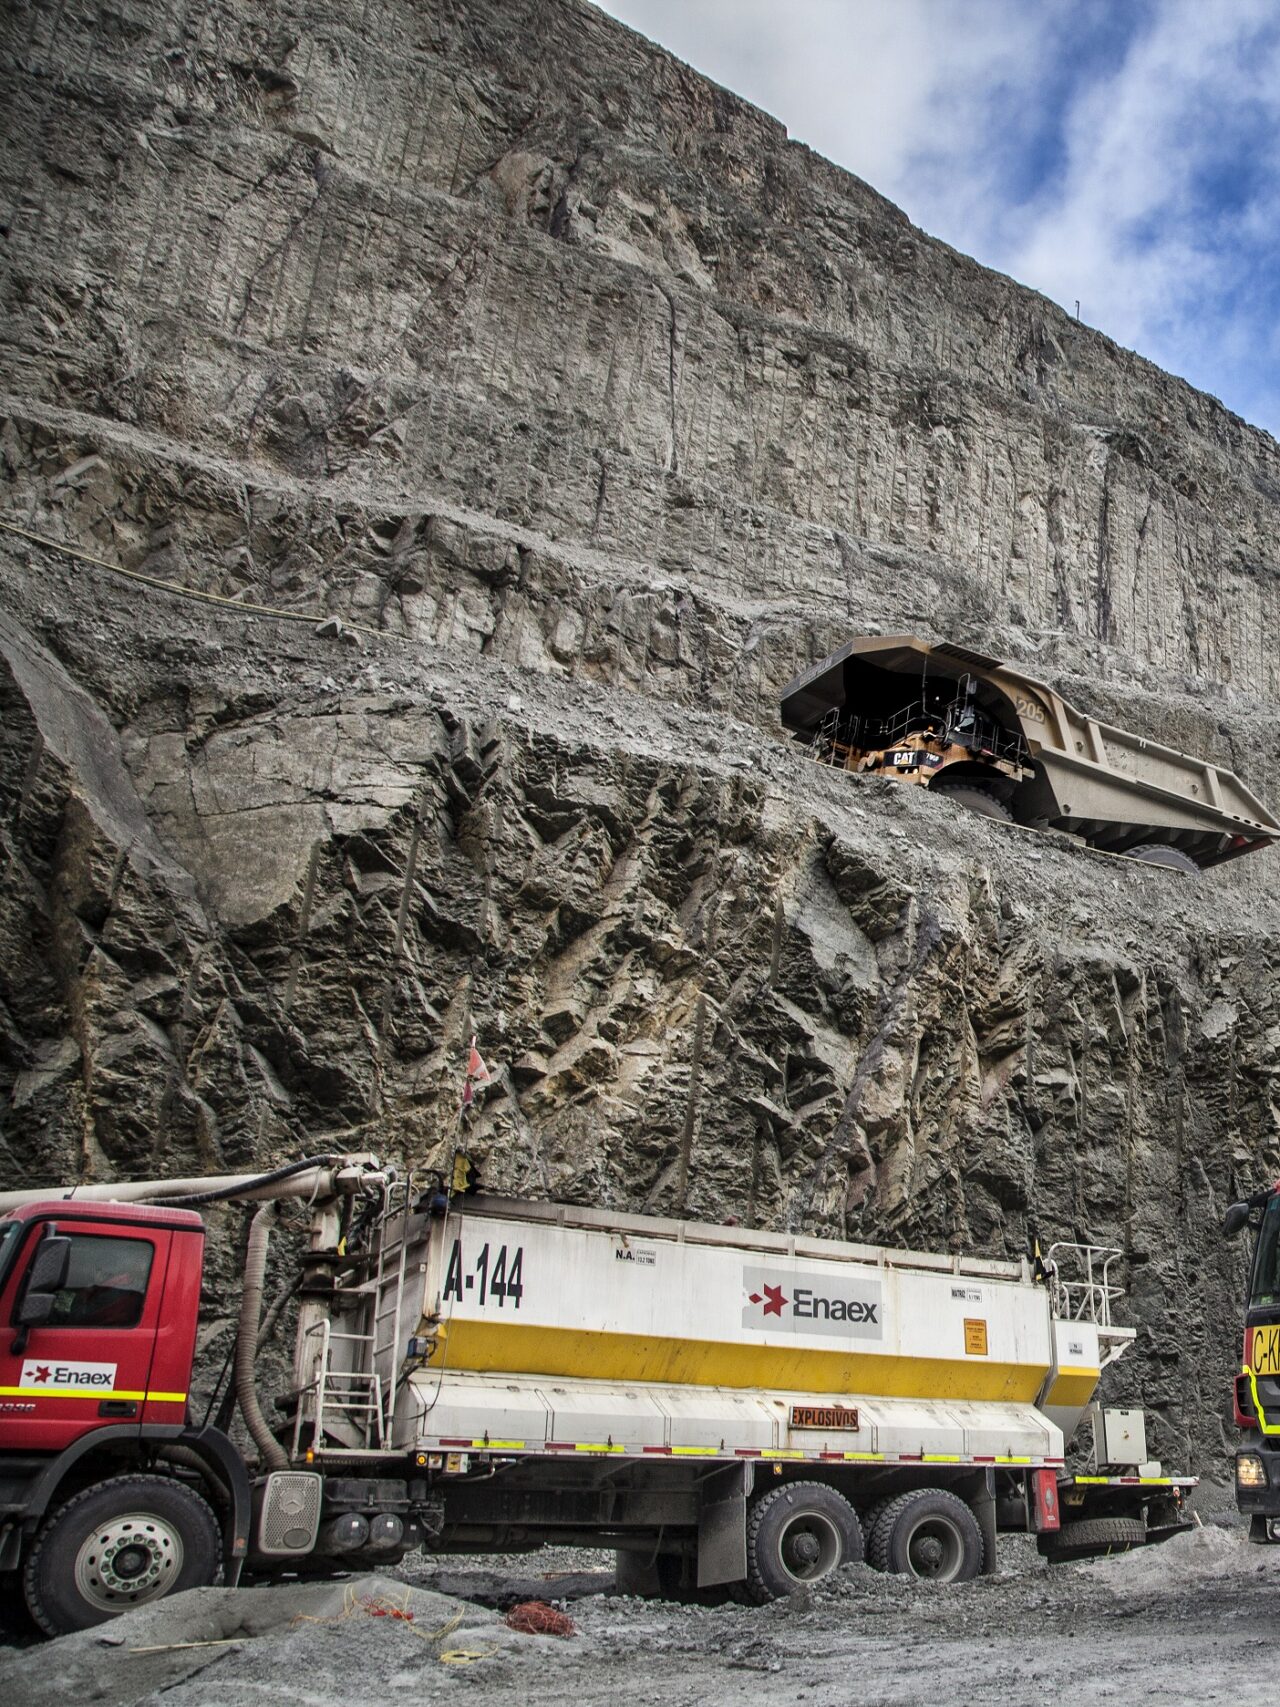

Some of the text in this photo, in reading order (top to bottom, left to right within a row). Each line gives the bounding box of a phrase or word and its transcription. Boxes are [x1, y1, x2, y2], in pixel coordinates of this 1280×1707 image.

[1016, 699, 1045, 723] 205
[893, 752, 915, 765] CAT
[615, 1249, 635, 1261] N.A.
[442, 1239, 523, 1308] A-144
[793, 1288, 878, 1324] Enaex
[53, 1367, 112, 1385] Enaex
[0, 1403, 36, 1412] 336
[793, 1408, 857, 1427] EXPLOSIVOS
